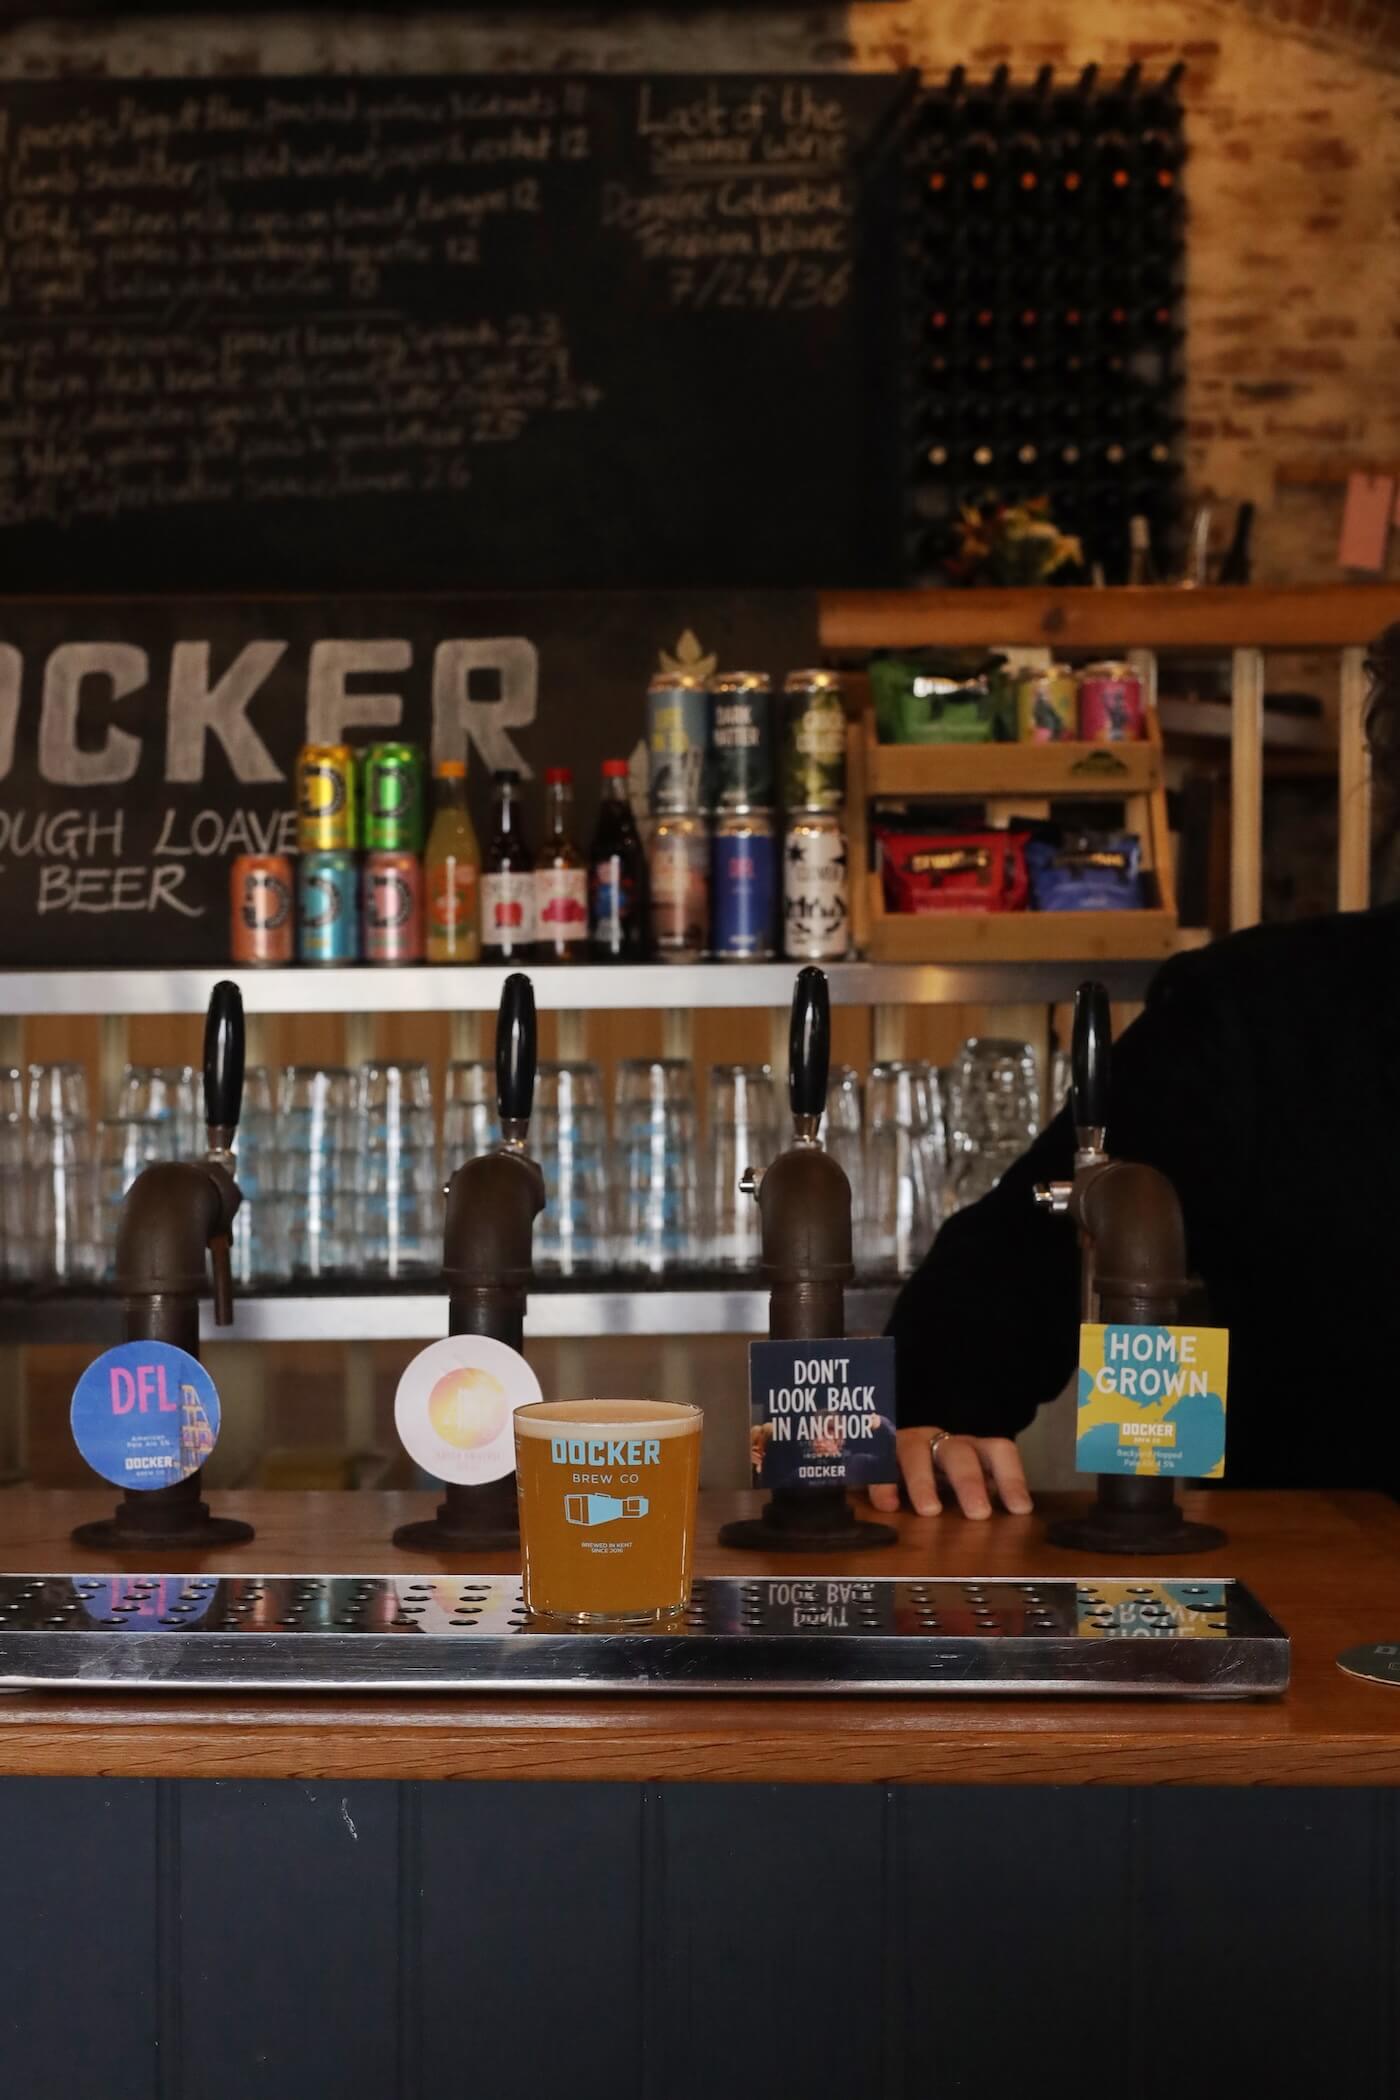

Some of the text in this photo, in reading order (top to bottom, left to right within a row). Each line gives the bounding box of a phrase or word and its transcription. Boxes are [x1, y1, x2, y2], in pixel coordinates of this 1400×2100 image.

[0, 637, 538, 787] CKER
[37, 864, 205, 915] BEER
[1110, 1333, 1197, 1363] HOME
[794, 1358, 850, 1385] DON'T
[1096, 1367, 1208, 1397] GROWN
[110, 1364, 177, 1415] DFL
[769, 1386, 875, 1413] LOOK BACK
[772, 1414, 873, 1441] IN ANCHOR
[1122, 1423, 1173, 1436] DOCKER
[125, 1456, 173, 1470] DOCKER
[551, 1438, 661, 1466] DOCKER
[572, 1473, 639, 1484] BREW CO
[799, 1465, 846, 1478] DOCKER
